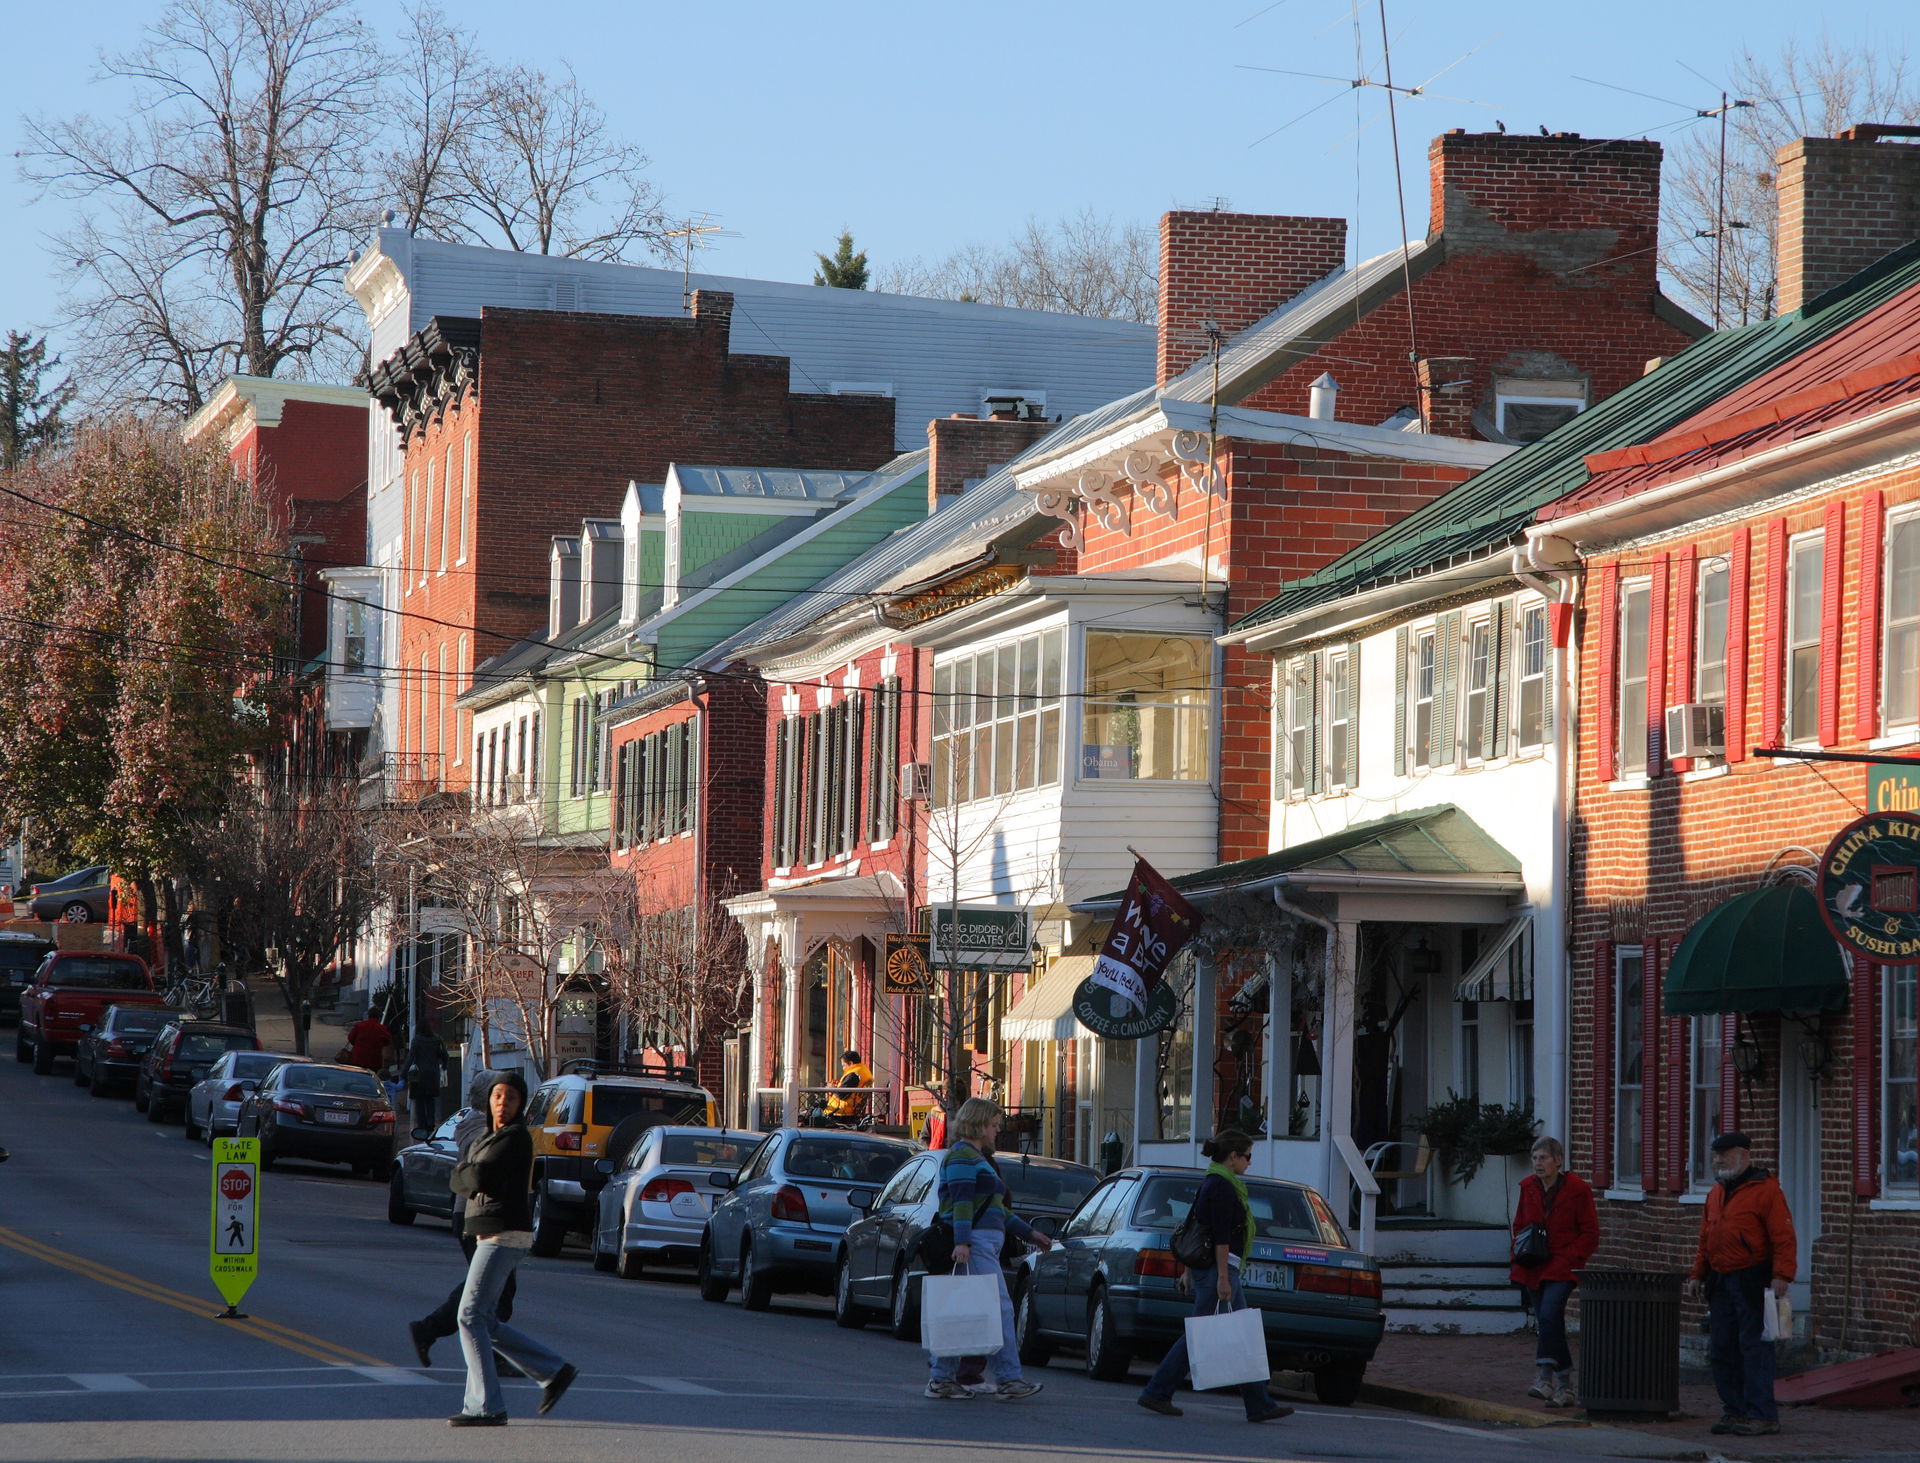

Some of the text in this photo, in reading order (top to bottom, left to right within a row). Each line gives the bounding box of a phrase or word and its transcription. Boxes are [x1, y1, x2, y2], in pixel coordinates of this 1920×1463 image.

[1083, 756, 1118, 767] Obama
[1877, 776, 1920, 811] Chin
[1830, 821, 1920, 876] CHINA KIT
[941, 923, 1004, 935] GRG DIDDEN
[1884, 917, 1903, 935] &
[1845, 925, 1920, 955] SUSHI BA
[1078, 1001, 1169, 1036] COFFEE & CANDLERY
[222, 1140, 252, 1151] STATE
[226, 1151, 247, 1161] LAW
[222, 1178, 250, 1191] STOP
[228, 1203, 243, 1212] FOR
[223, 1256, 245, 1264] WITHIN
[214, 1265, 253, 1273] CROSSWALK
